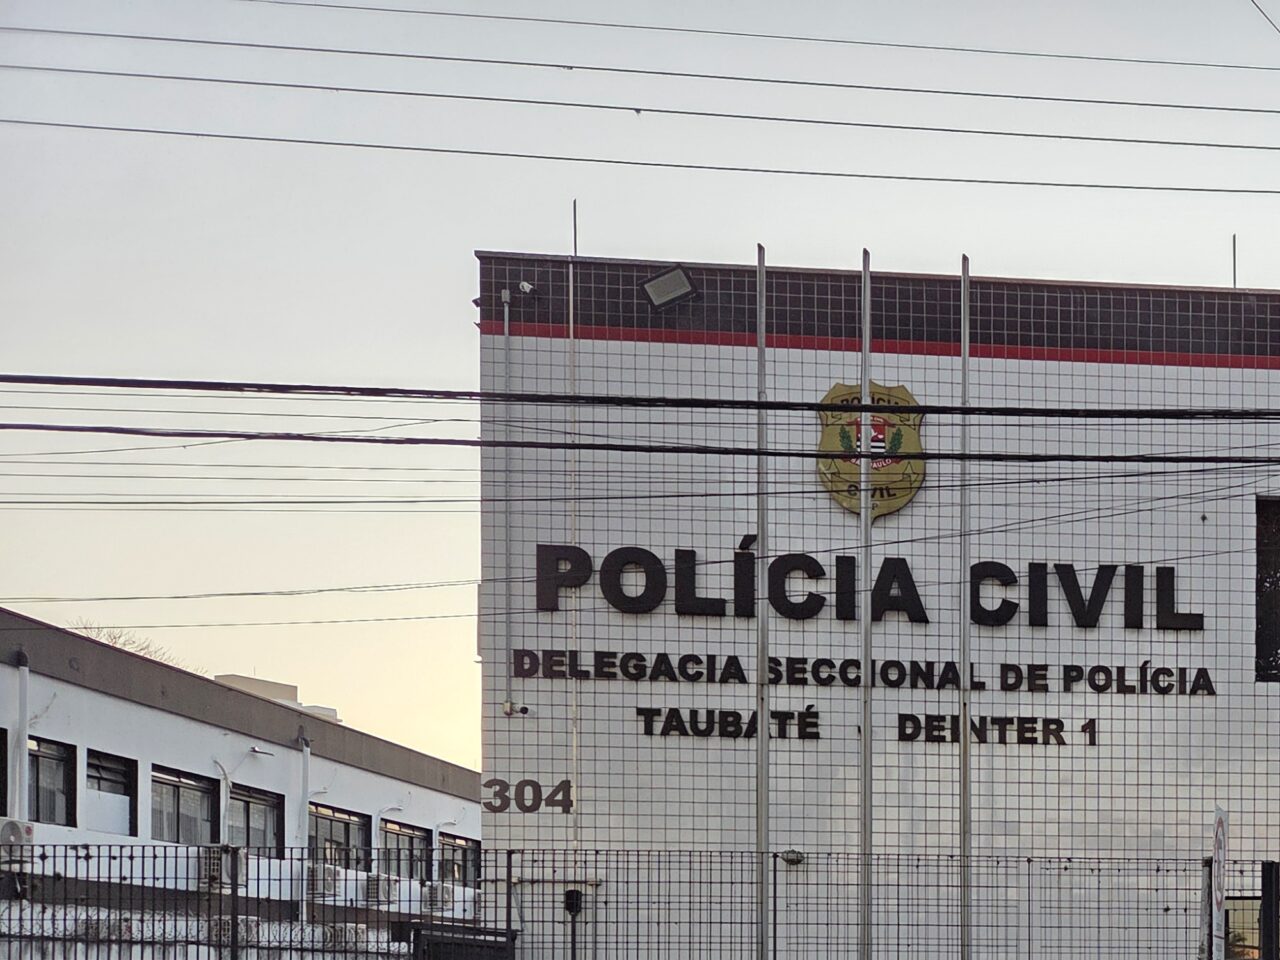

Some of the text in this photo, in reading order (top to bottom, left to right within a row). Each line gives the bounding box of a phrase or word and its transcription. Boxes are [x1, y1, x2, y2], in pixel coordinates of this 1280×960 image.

[847, 484, 897, 498] CIL
[536, 534, 1204, 630] POLÍCIA CIVIL
[513, 649, 1216, 695] DELEGACIA SECCIONAL DE POLÍCIA
[636, 704, 1097, 746] TAUBATÉ DEINTER 1
[482, 778, 574, 814] 304
